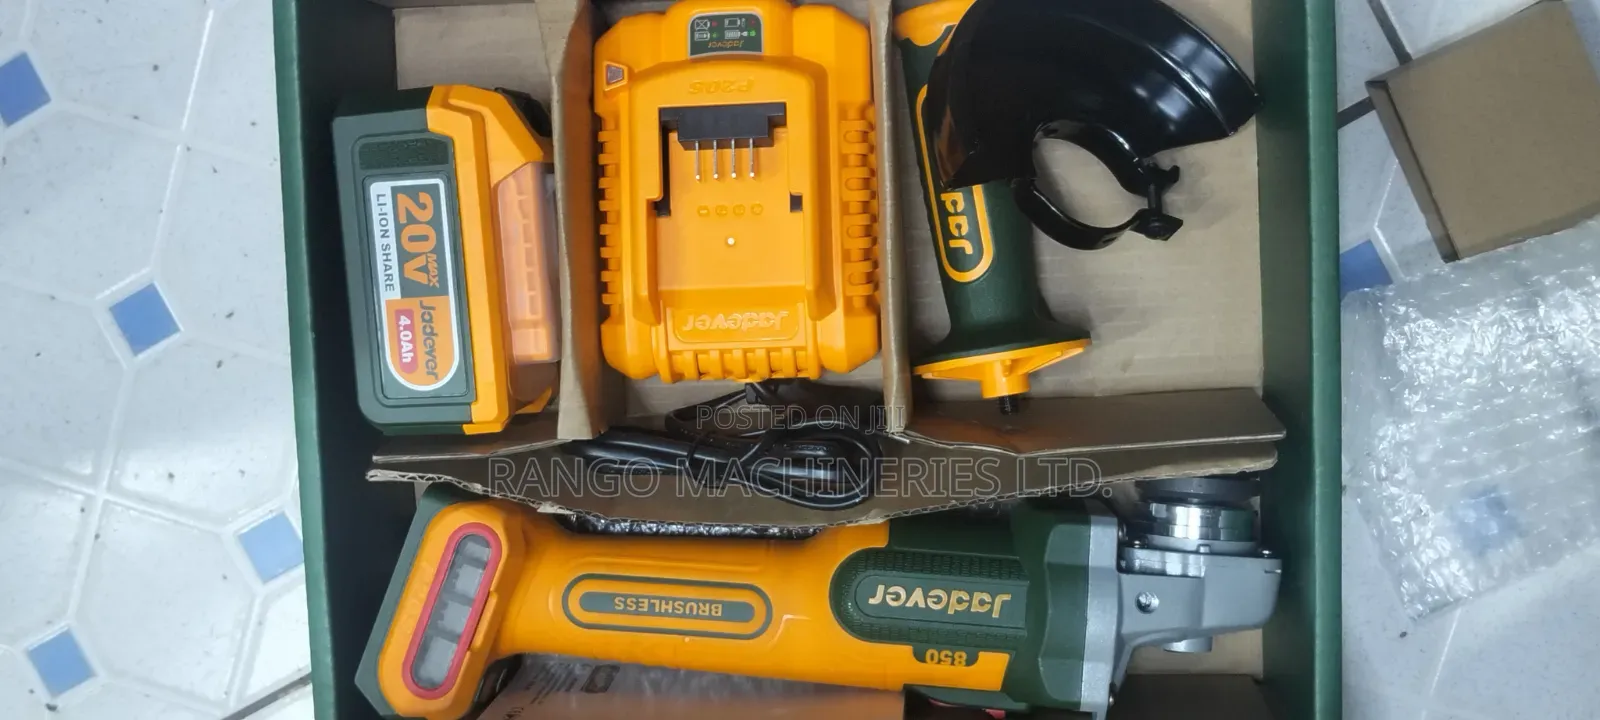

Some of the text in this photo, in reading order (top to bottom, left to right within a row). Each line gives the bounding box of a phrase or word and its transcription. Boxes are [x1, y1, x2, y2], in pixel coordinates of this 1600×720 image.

[377, 194, 395, 292] LI-ION SHARE
[427, 253, 439, 288] MAX
[682, 310, 790, 332] Jadever
[398, 315, 414, 363] 4.0Ah
[420, 301, 439, 380] Jadever
[614, 597, 722, 616] BRUSHLESS
[868, 585, 1011, 618] Jadever
[925, 649, 967, 667] 850
